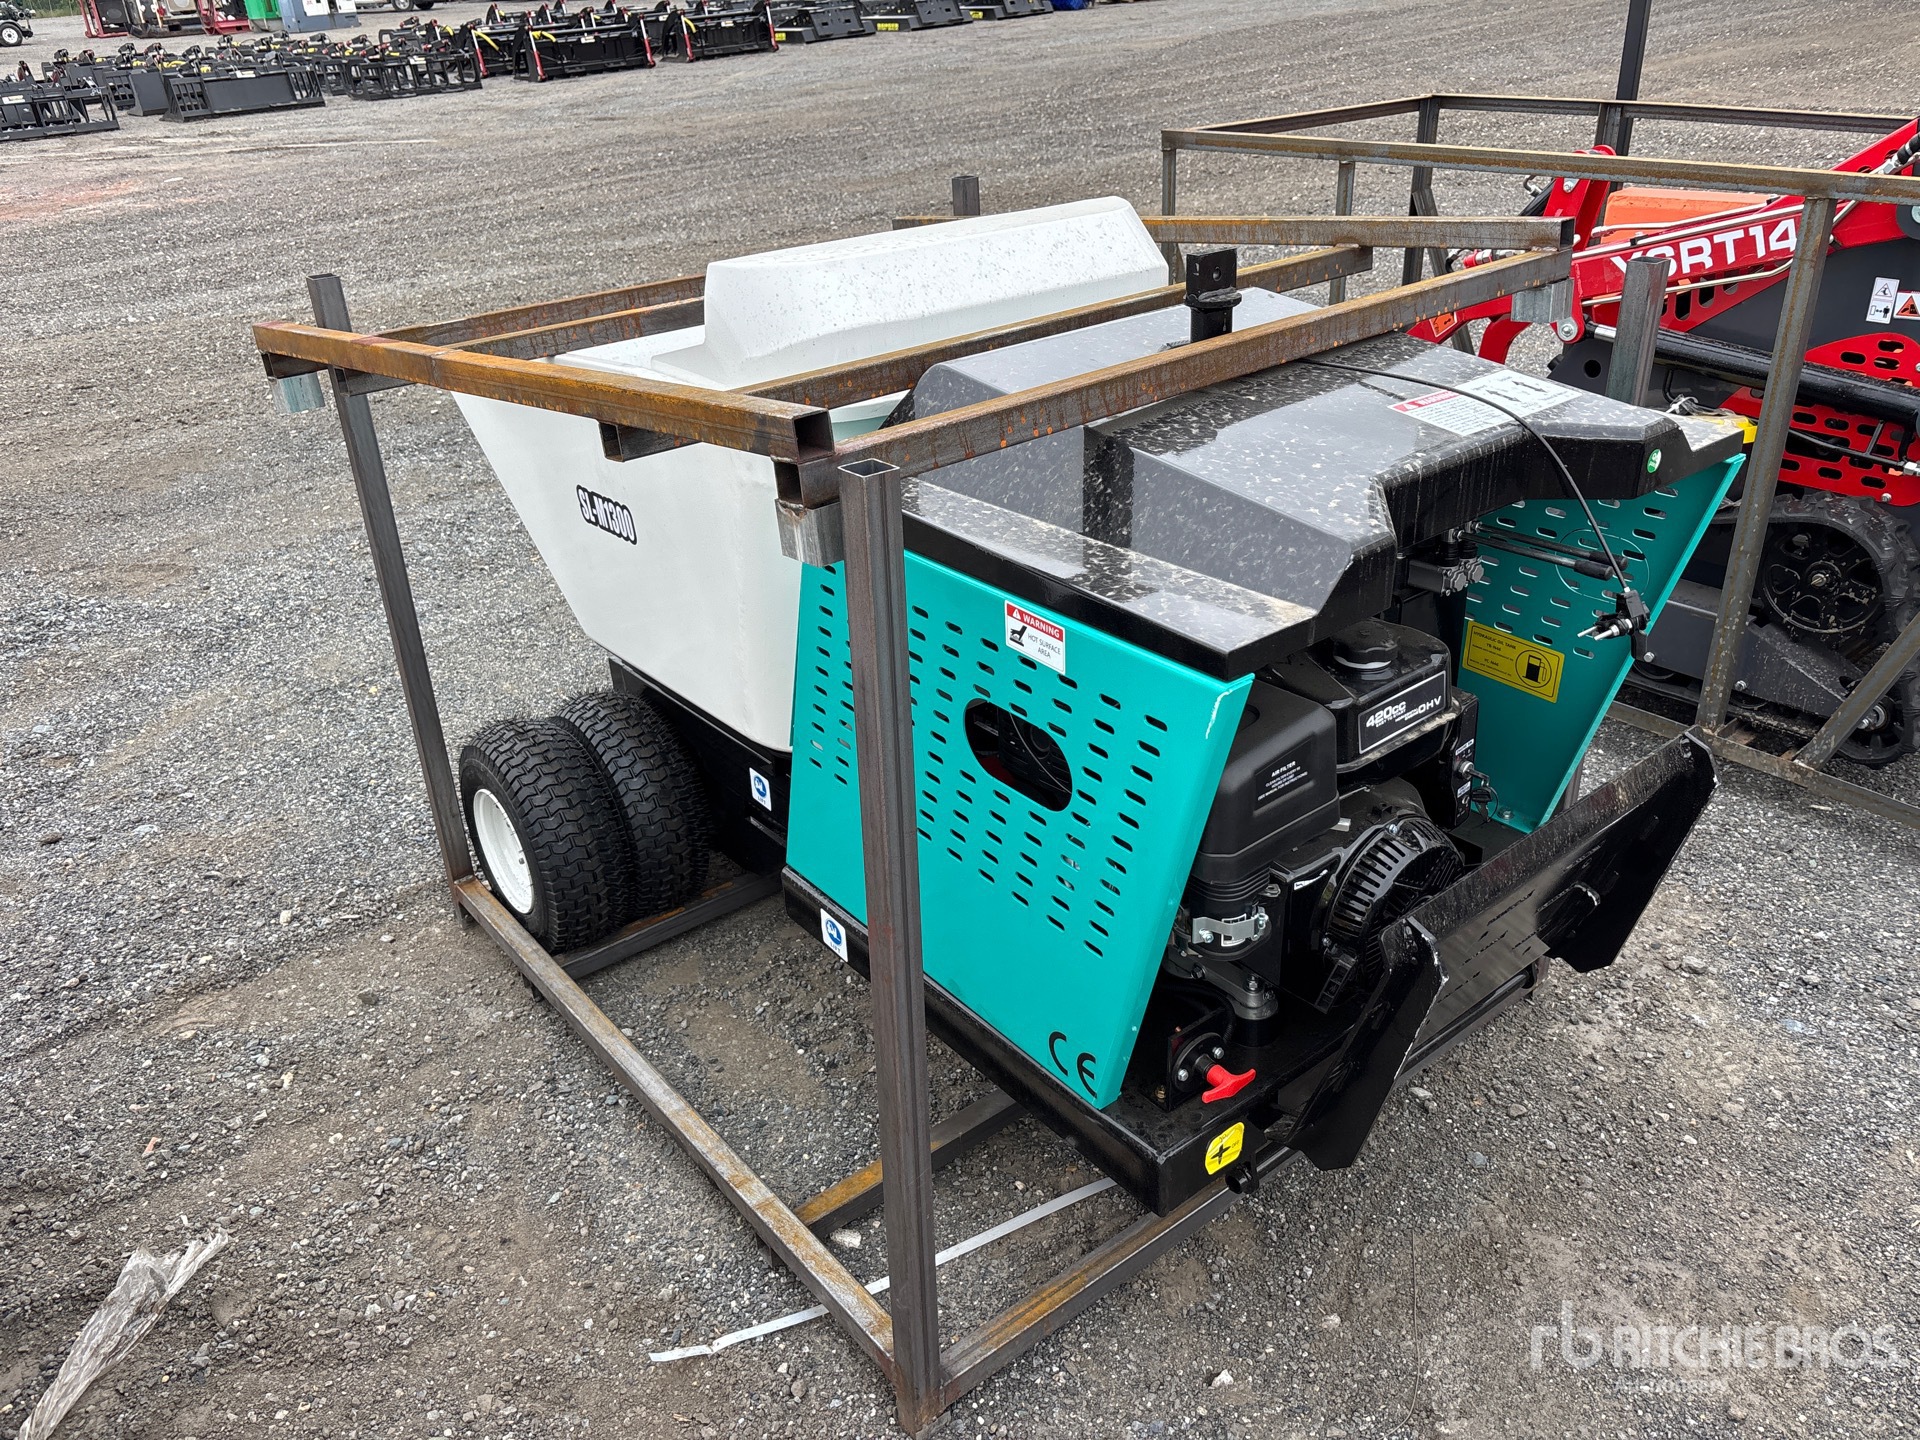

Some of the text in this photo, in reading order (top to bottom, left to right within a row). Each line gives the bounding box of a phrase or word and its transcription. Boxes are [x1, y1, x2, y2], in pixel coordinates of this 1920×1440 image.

[577, 488, 635, 542] SL-M1300
[1022, 613, 1061, 639] WARNING
[1027, 633, 1061, 656] HOT SURFACE
[1037, 647, 1051, 659] AREA
[1366, 695, 1442, 728] 420cc OHV
